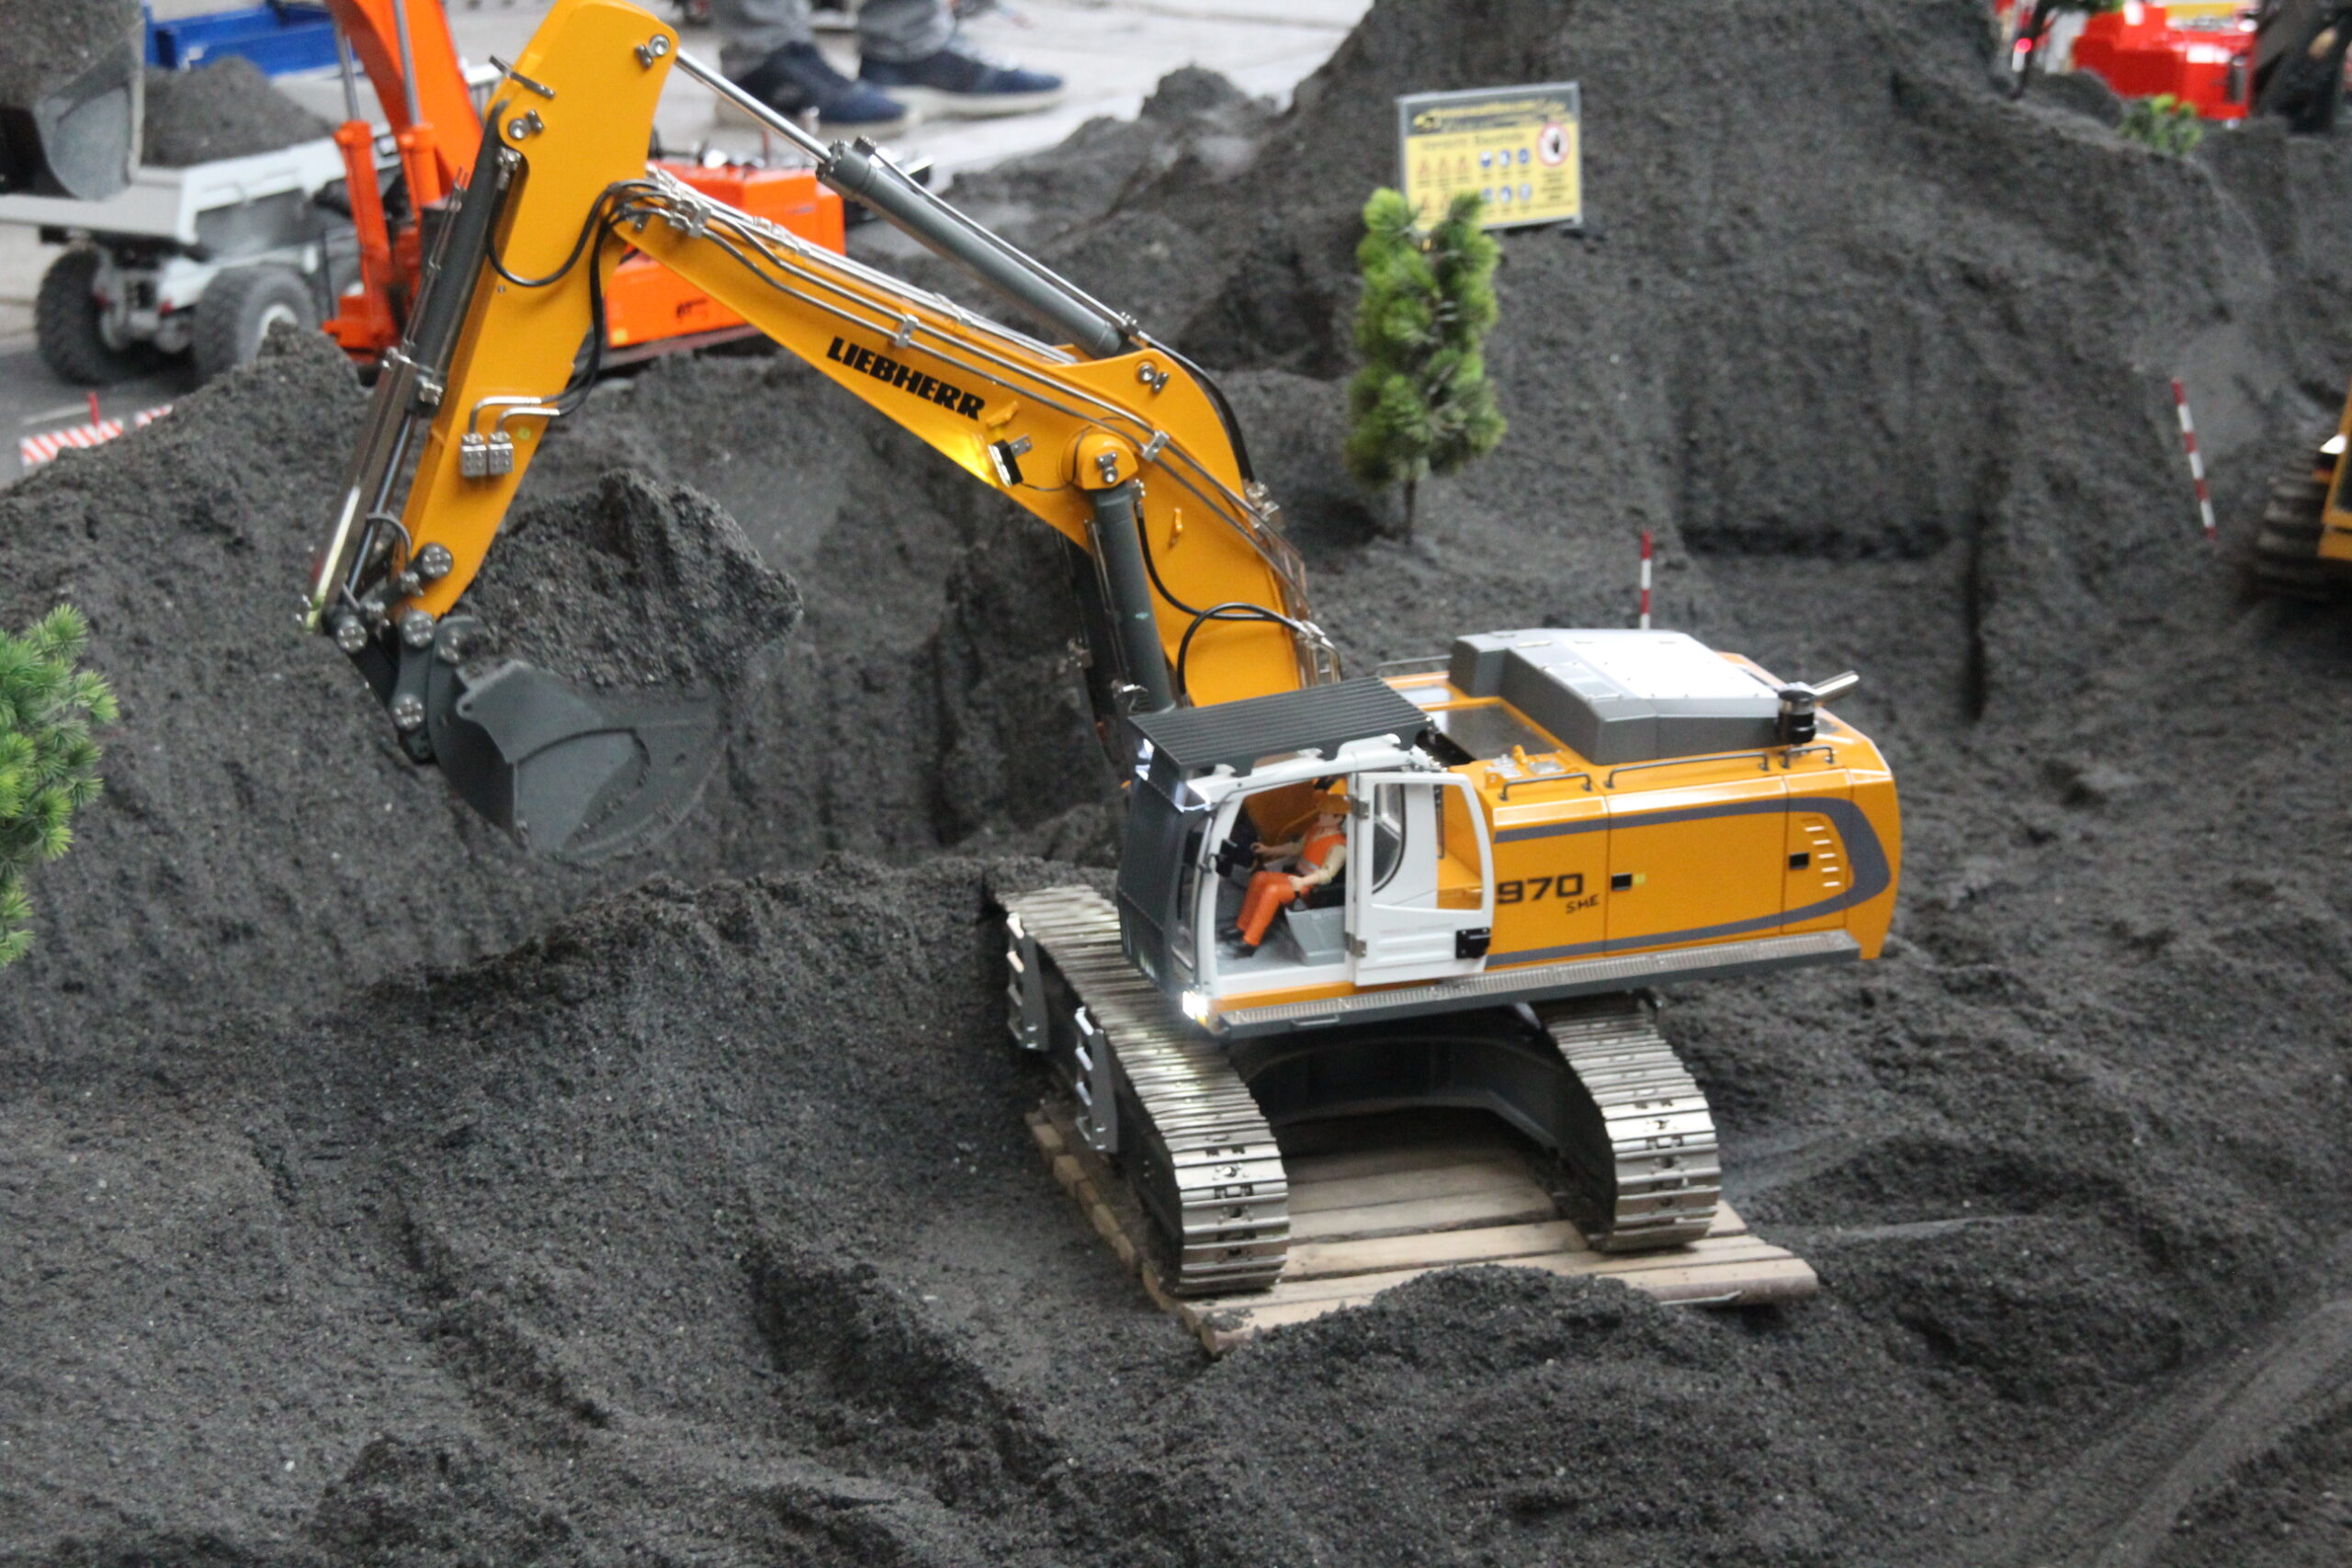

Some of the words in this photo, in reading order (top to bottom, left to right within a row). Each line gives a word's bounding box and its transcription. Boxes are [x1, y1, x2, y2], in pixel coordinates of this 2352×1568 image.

[827, 335, 986, 422] LIEBHERR
[1497, 874, 1584, 905] 970
[1565, 895, 1599, 914] SME
